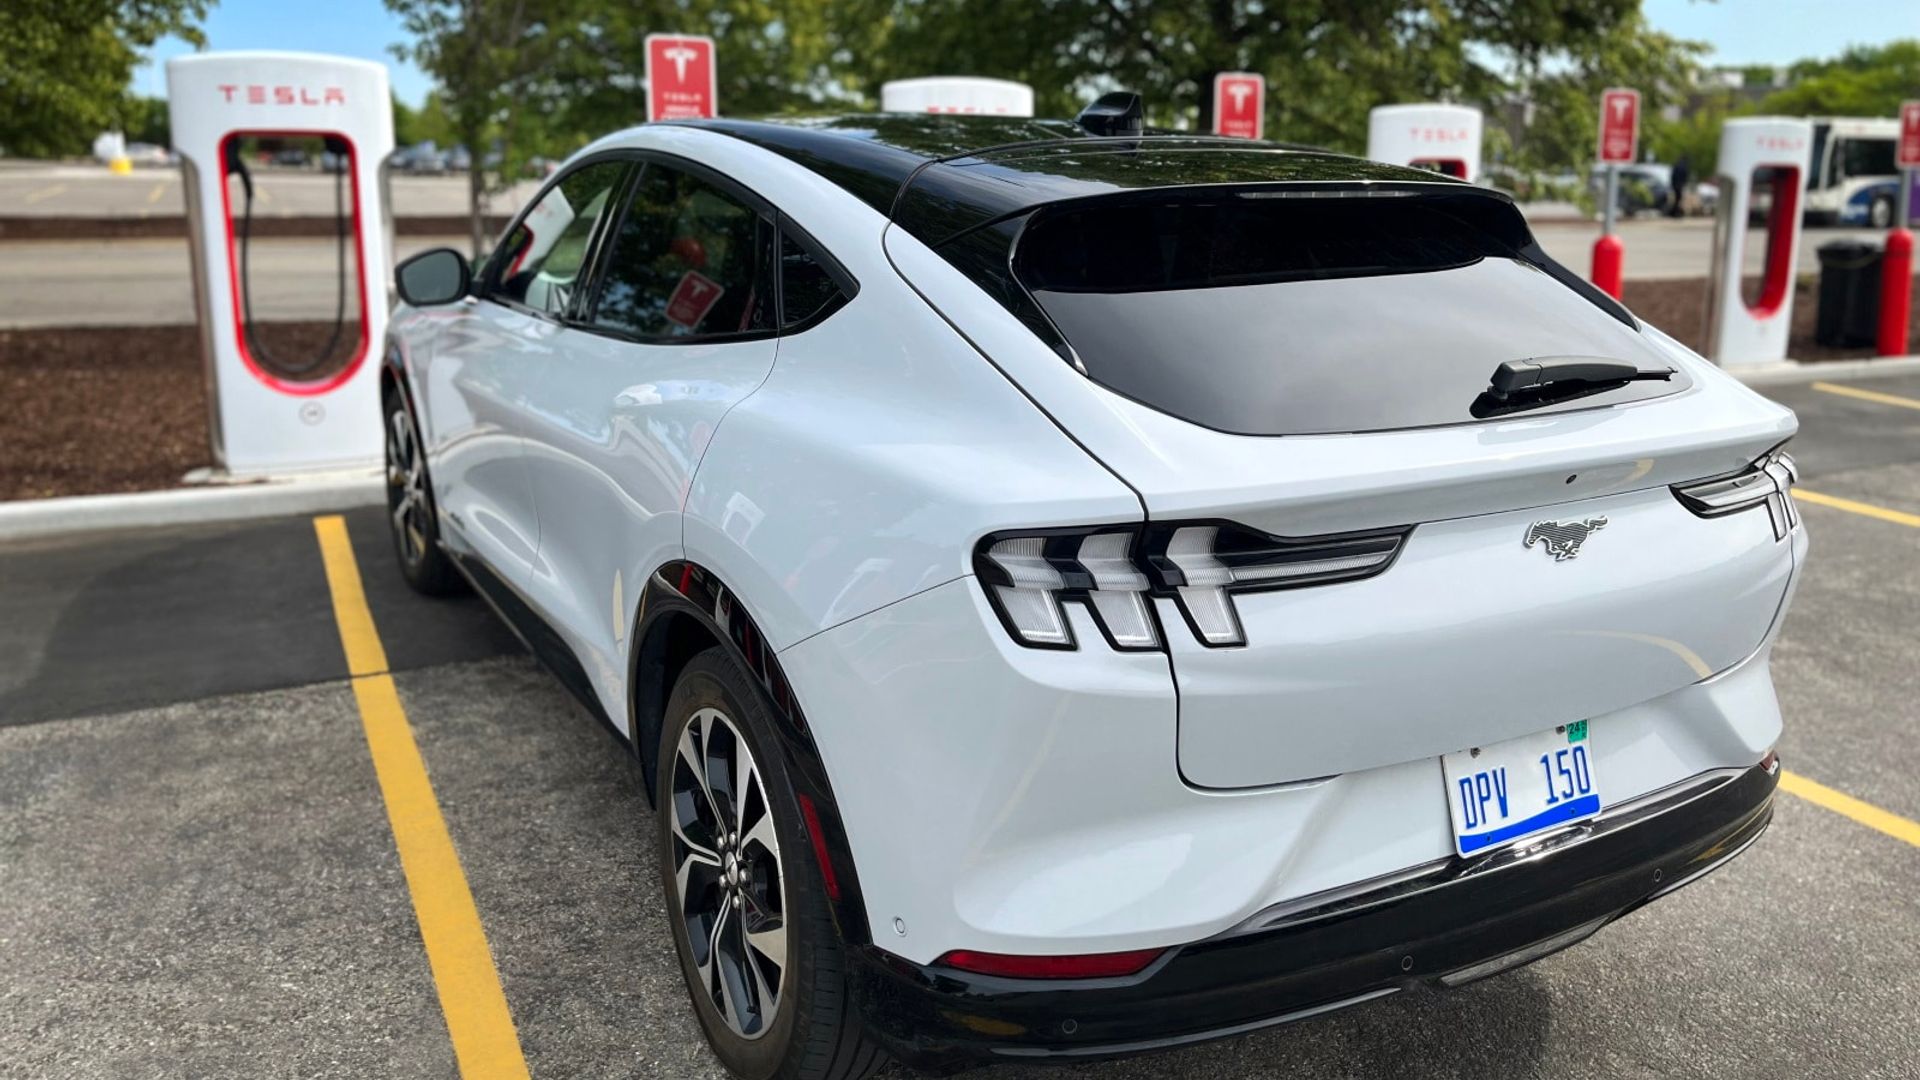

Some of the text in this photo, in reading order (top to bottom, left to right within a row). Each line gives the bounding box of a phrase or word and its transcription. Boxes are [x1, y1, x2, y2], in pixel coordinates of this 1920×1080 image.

[217, 84, 345, 105] TESLA
[1458, 746, 1591, 829] DPV 150
